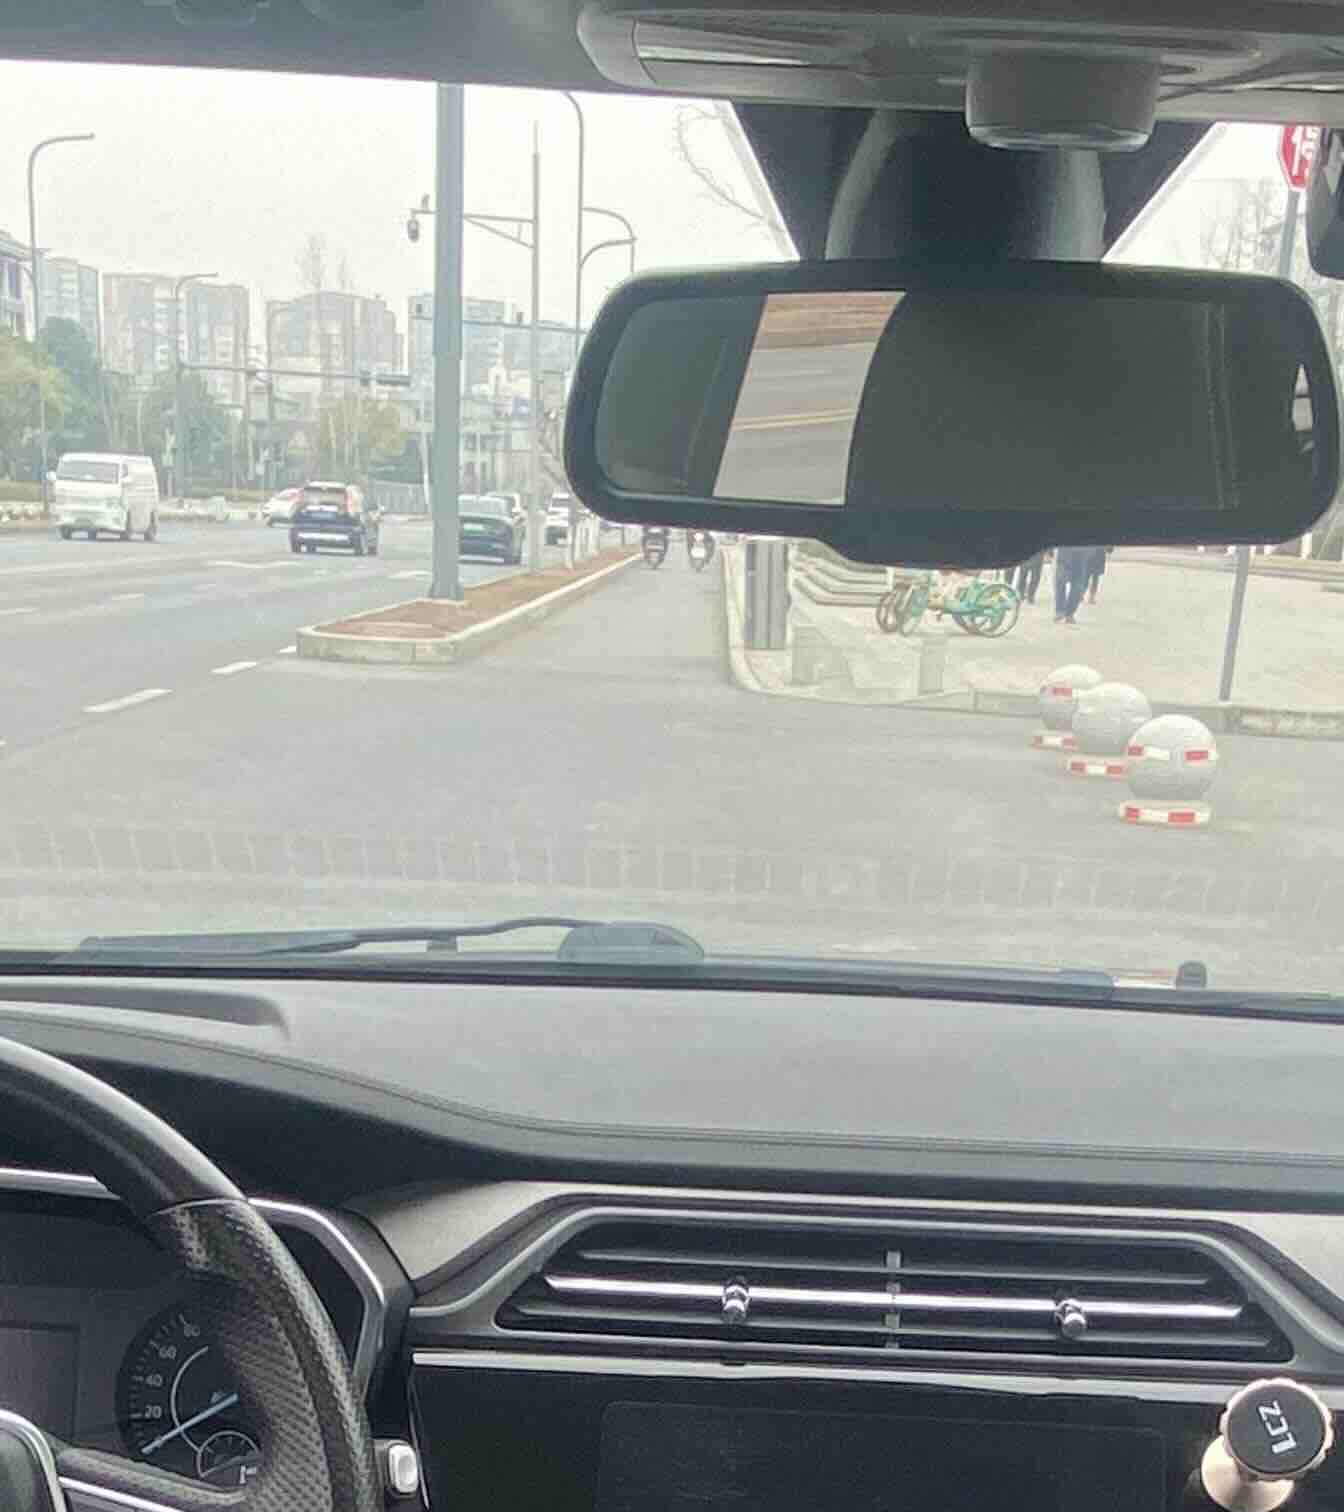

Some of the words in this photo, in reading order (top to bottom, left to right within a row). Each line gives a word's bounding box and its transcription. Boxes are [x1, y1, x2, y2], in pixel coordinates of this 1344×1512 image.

[158, 1346, 177, 1359] 60
[145, 1373, 163, 1387] 40
[145, 1404, 162, 1418] 20
